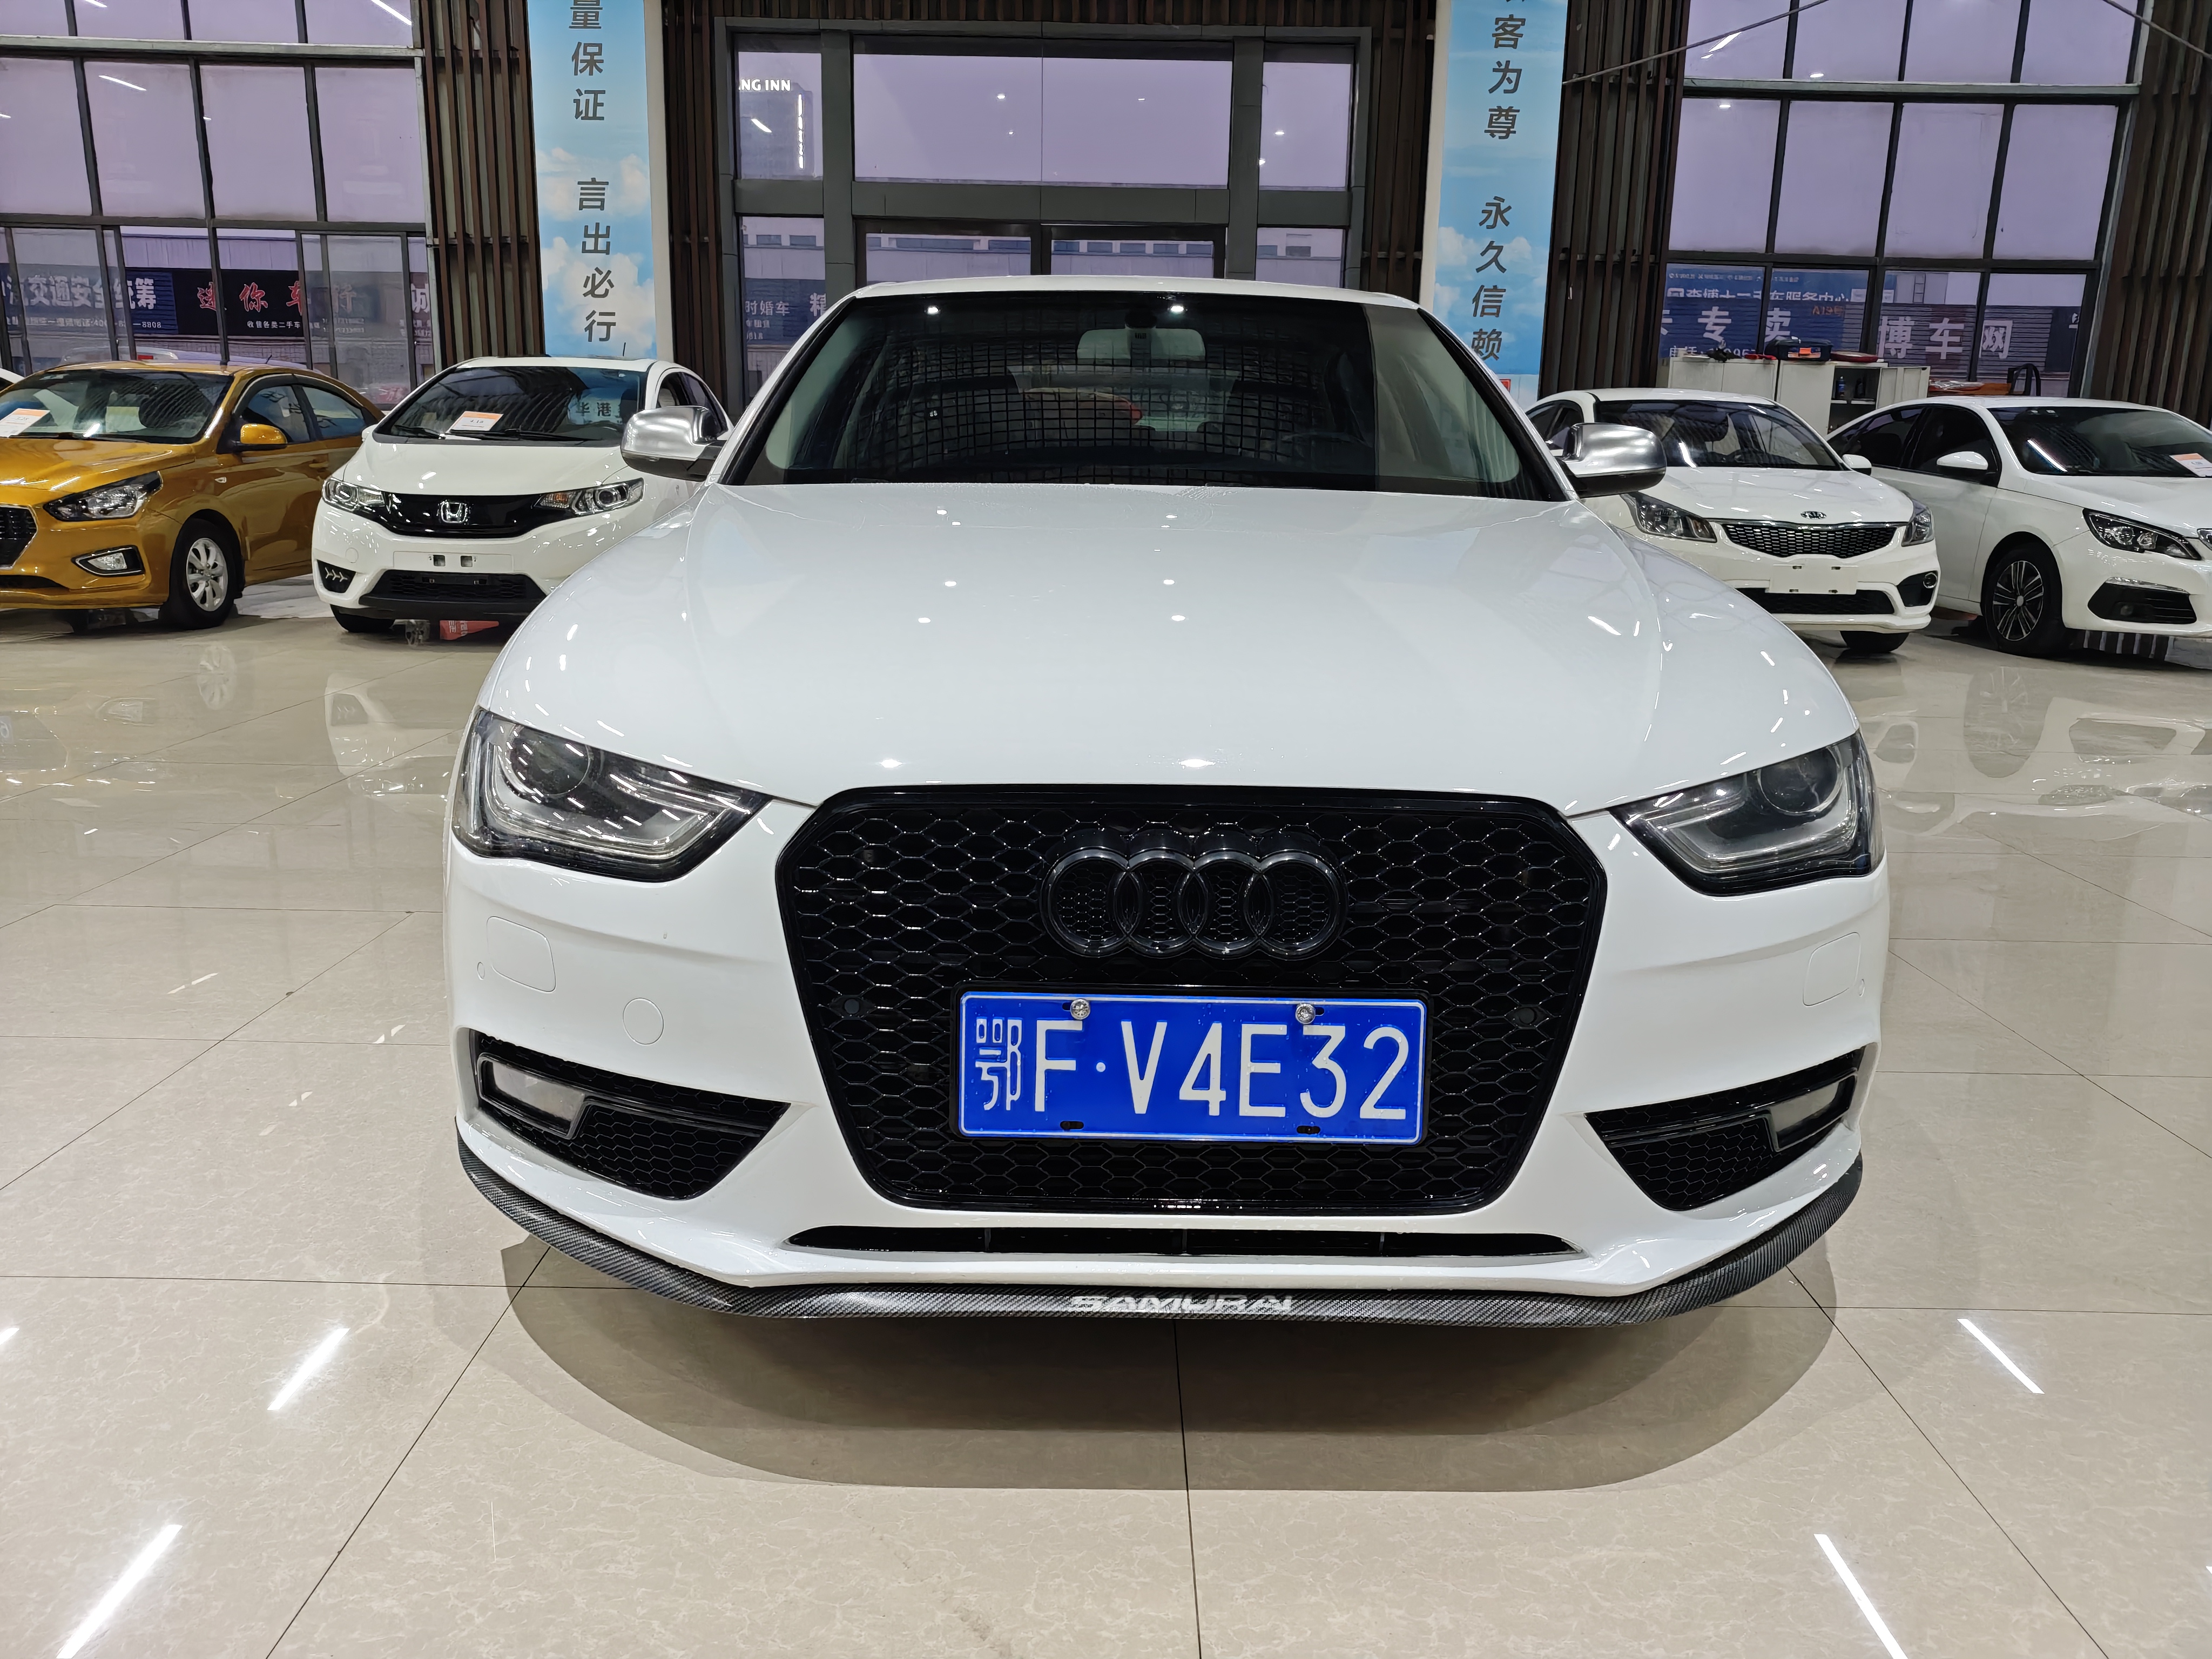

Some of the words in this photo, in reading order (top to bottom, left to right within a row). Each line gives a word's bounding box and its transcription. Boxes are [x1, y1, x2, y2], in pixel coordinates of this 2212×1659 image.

[569, 0, 605, 120] 量保证
[739, 79, 761, 91] NG
[765, 79, 791, 91] INN
[1484, 0, 1526, 139] 客为尊
[577, 178, 616, 342] 言出必行
[1471, 196, 1512, 361] 永久信赖
[1072, 1294, 1293, 1314] SAMURAI
